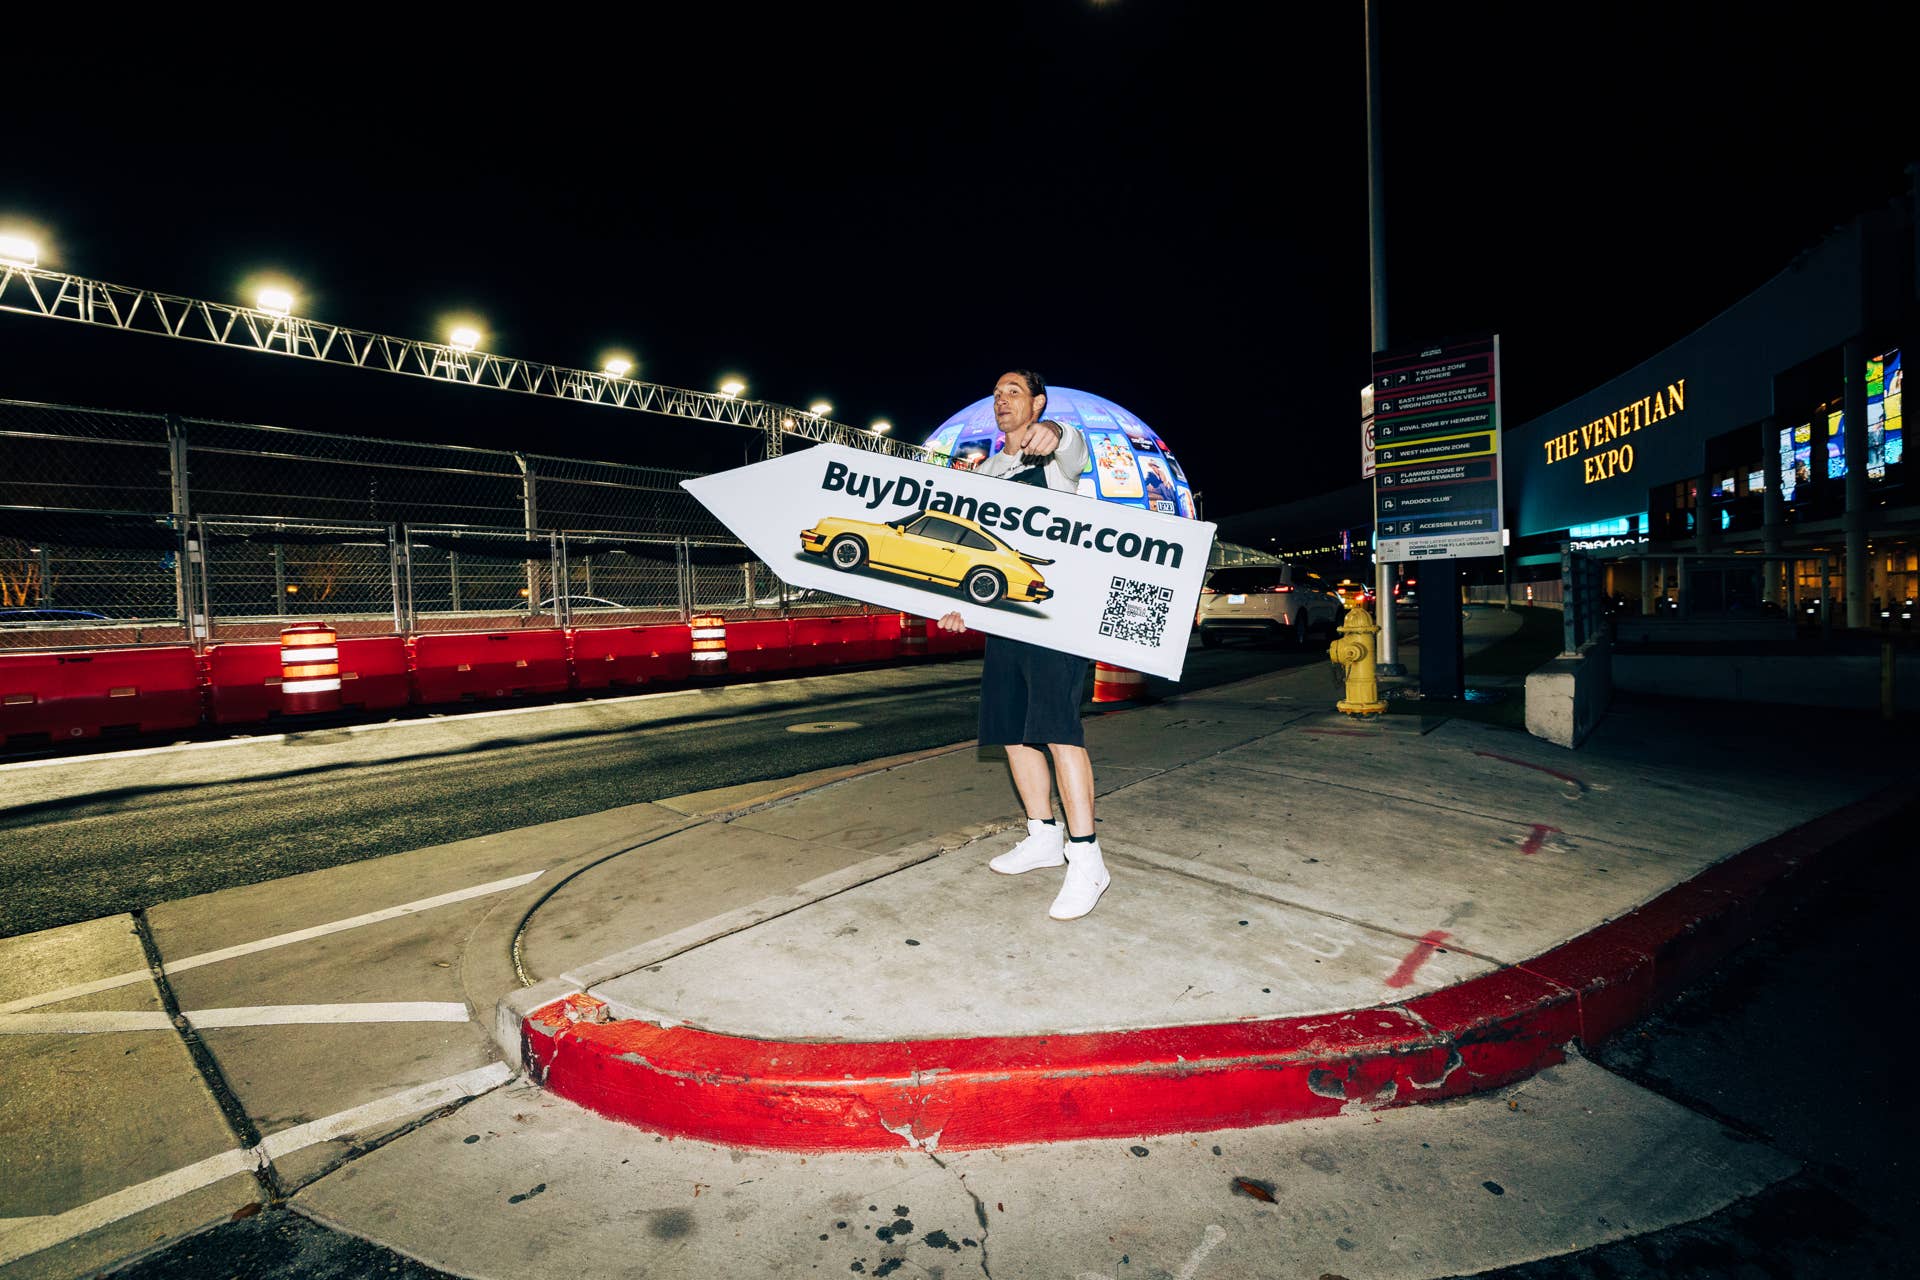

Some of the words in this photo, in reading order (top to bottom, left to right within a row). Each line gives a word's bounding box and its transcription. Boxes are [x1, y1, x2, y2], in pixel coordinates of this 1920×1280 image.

[1447, 362, 1466, 371] ZONE
[1425, 371, 1451, 380] SPHERE
[1416, 392, 1447, 401] HARMON
[1448, 387, 1467, 396] ZONE
[1422, 398, 1449, 407] HOTELS
[1463, 391, 1487, 400] VEGAS
[1421, 421, 1440, 429] ZONE
[1544, 430, 1580, 465] THE
[1581, 379, 1685, 450] VENETIAN
[1419, 446, 1450, 454] HARMON
[1451, 442, 1471, 450] ZONE
[1583, 443, 1634, 484] EXPO
[1400, 469, 1436, 478] FLAMINGO
[1400, 475, 1431, 484] CAESARS
[1431, 472, 1465, 481] REWARDS
[821, 460, 1184, 569] BuyDianesCar.com
[1419, 520, 1458, 529] ACCESSIBLE
